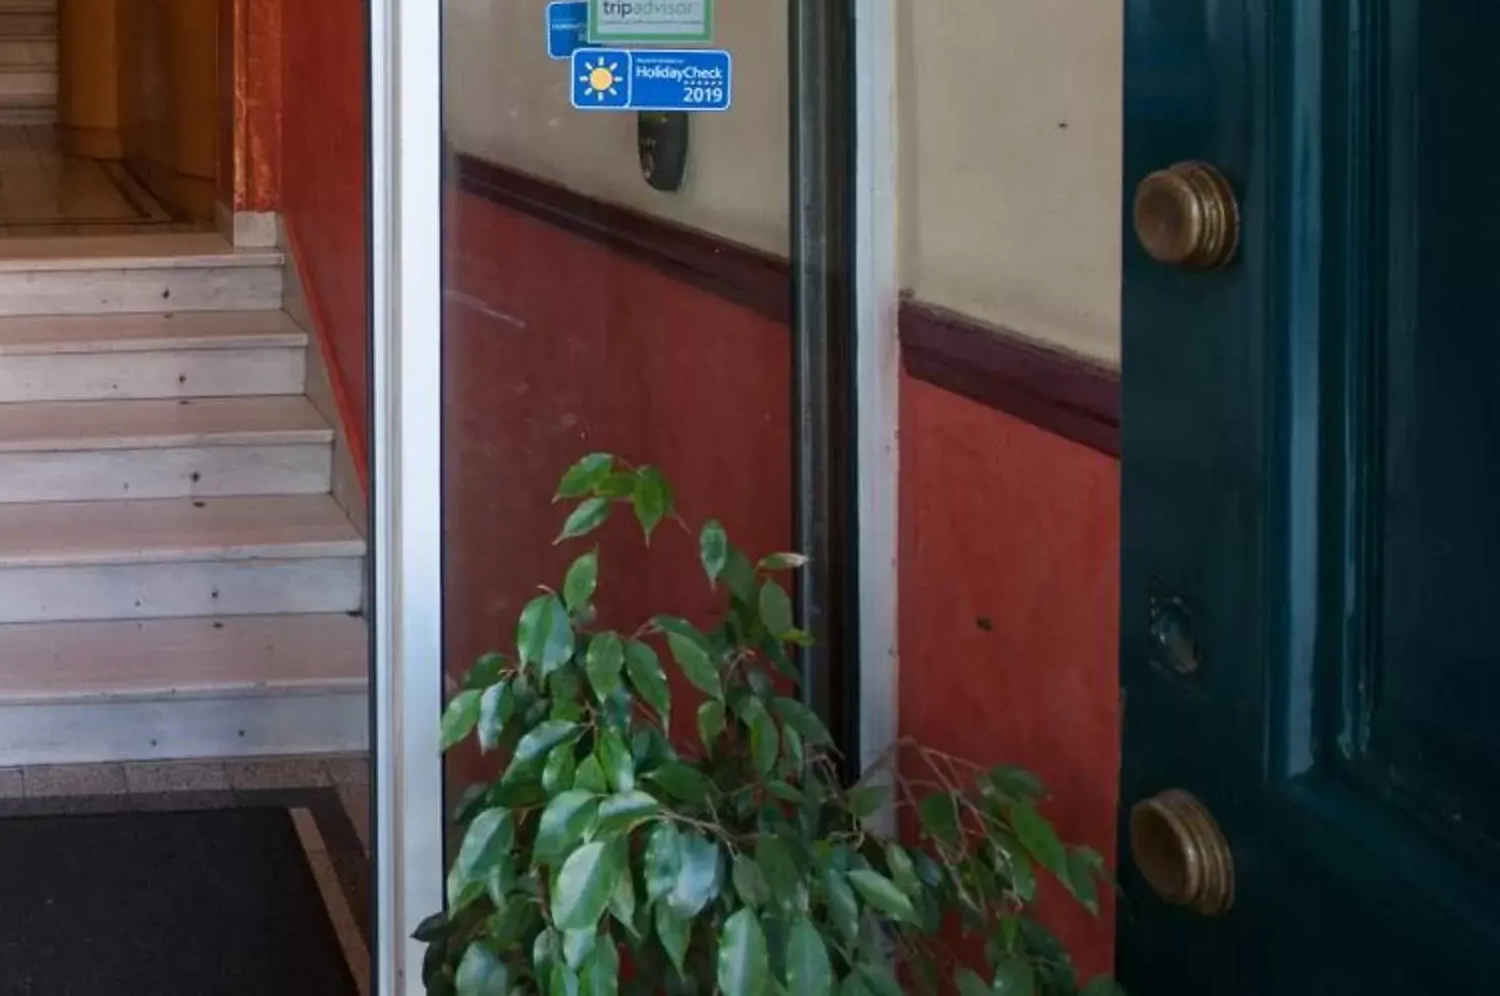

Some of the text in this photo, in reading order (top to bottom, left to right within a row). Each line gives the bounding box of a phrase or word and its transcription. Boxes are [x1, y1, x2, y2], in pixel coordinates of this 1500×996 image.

[603, 0, 693, 18] tripadvisor
[636, 66, 723, 82] HolidayCheck
[683, 87, 723, 103] 2019
